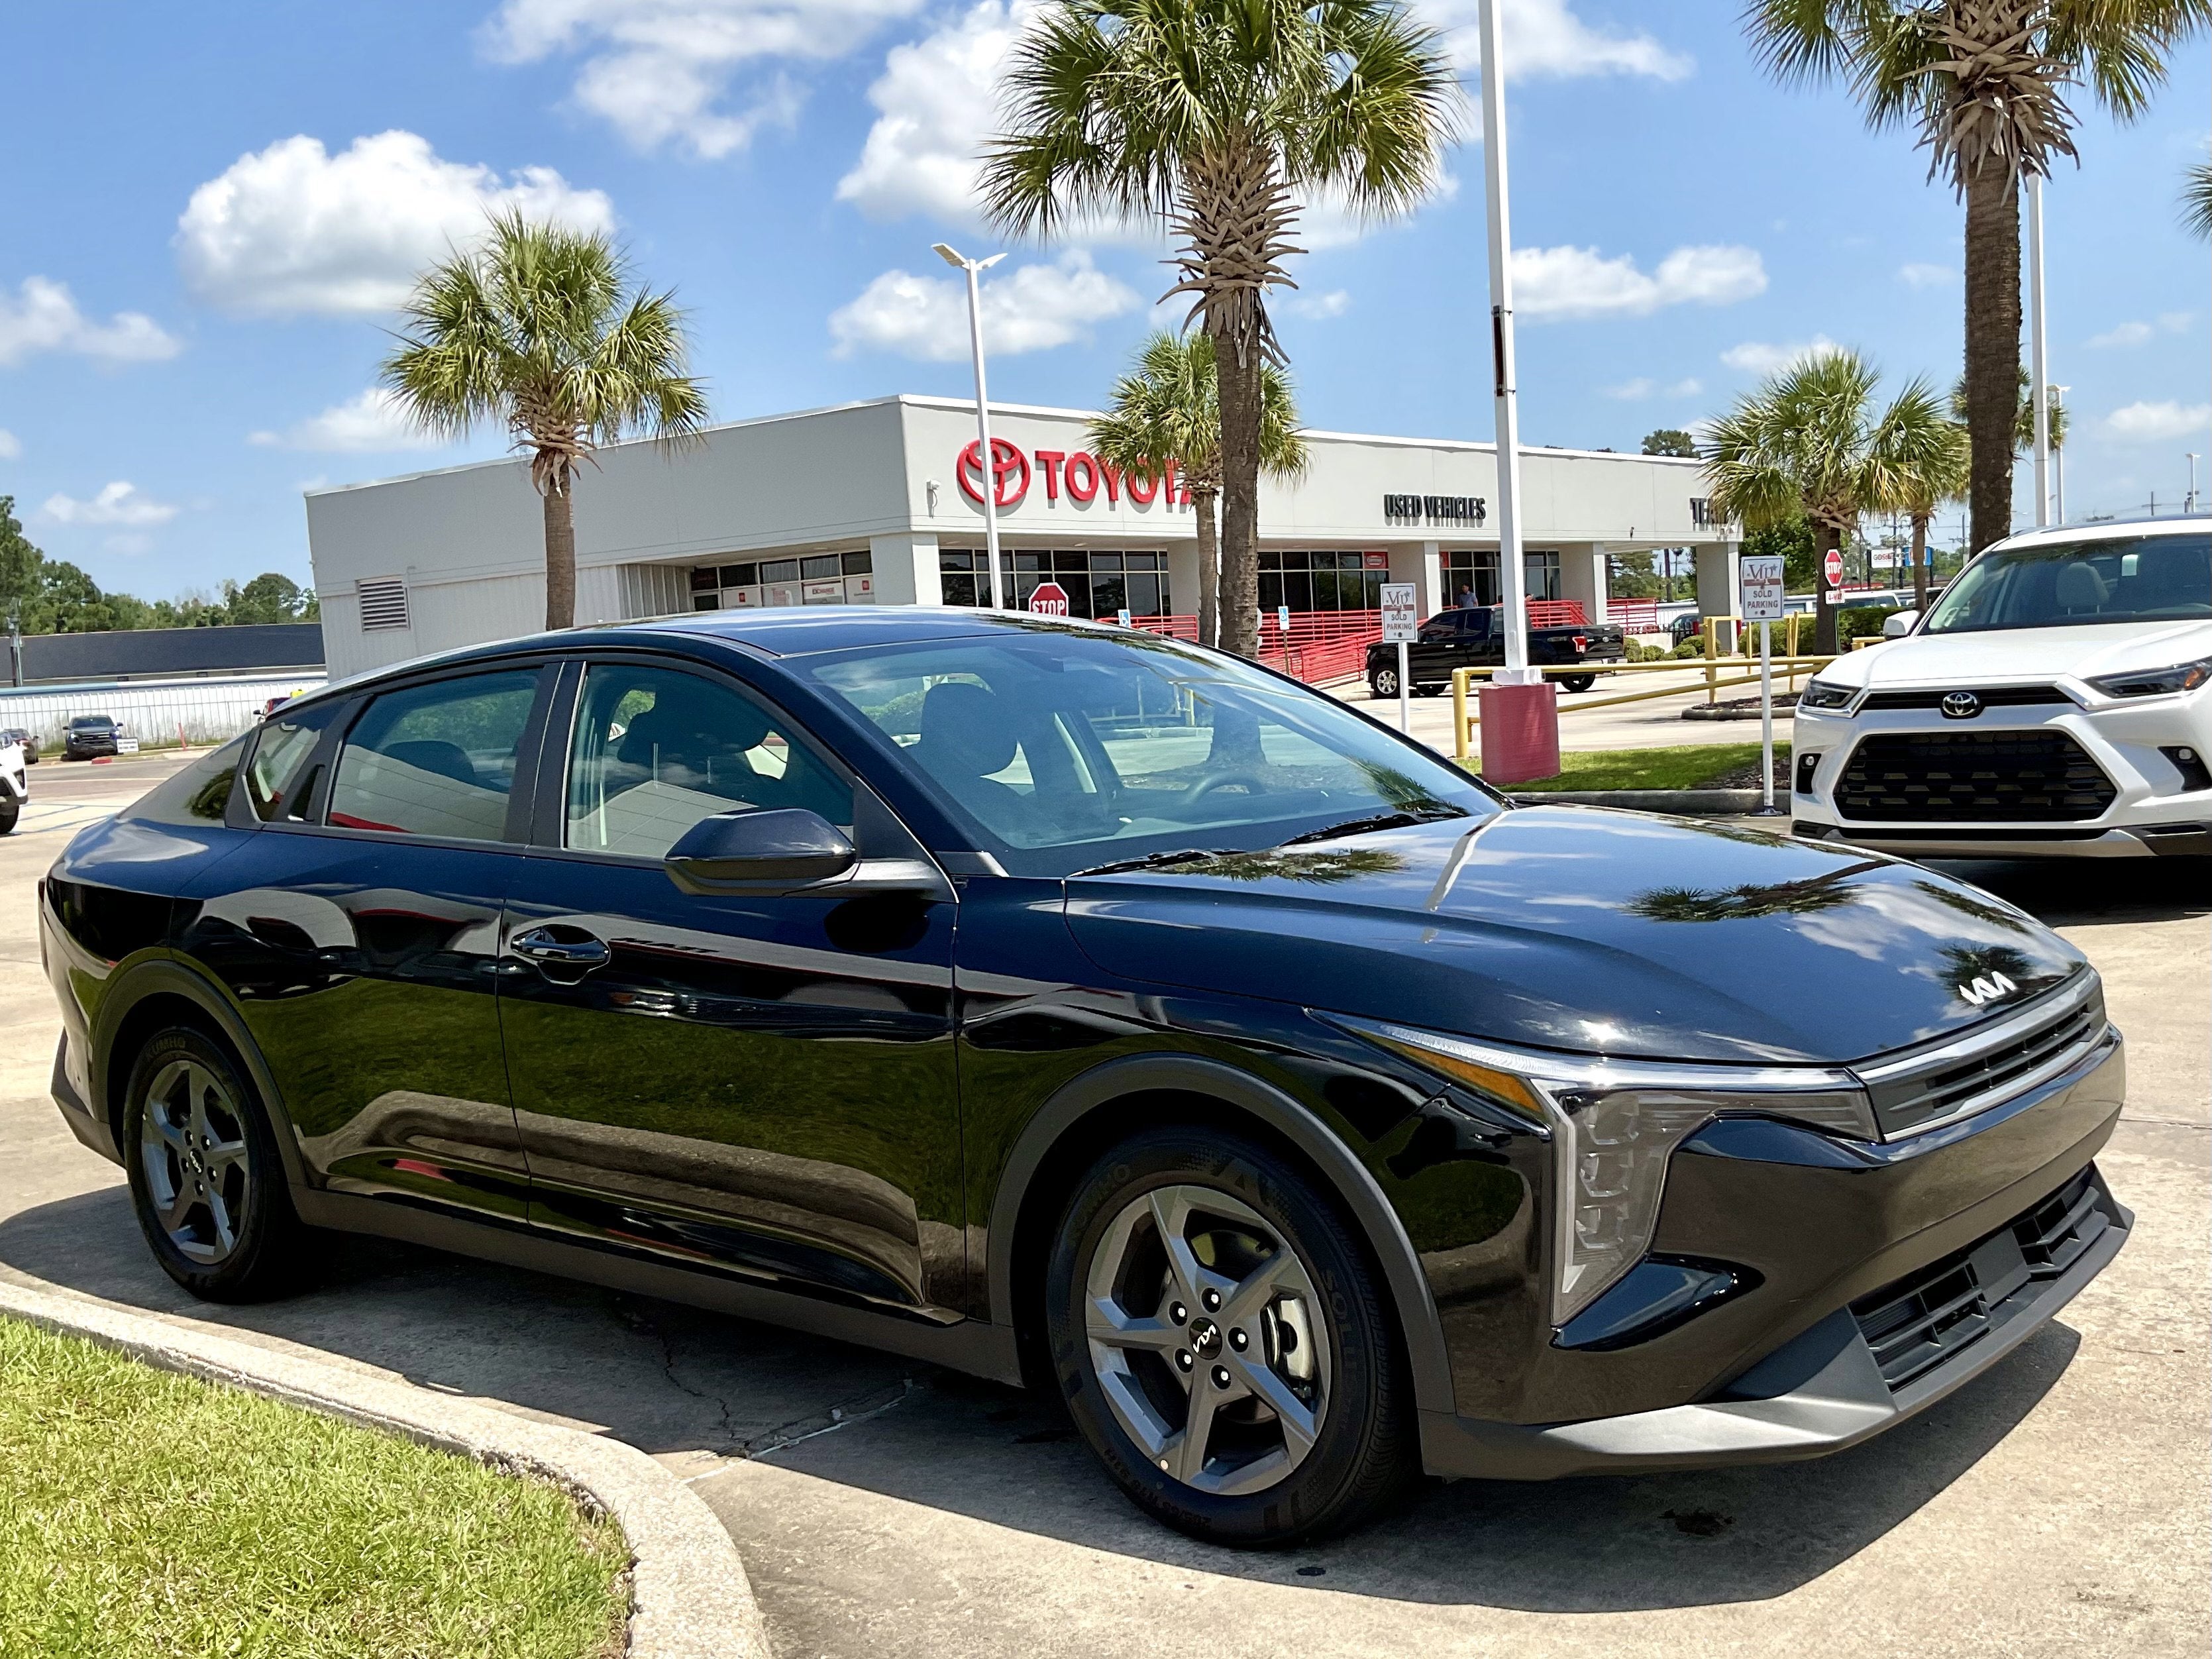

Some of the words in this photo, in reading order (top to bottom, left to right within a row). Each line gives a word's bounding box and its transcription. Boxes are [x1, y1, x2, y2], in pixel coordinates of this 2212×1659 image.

[1035, 450, 1192, 504] TOYOT
[1384, 494, 1422, 517] USED
[1424, 496, 1486, 519] VEHICLES
[1826, 562, 1842, 574] STOP
[1753, 590, 1772, 598] SOLD
[1032, 599, 1065, 615] STOP
[1747, 600, 1778, 609] PARKING
